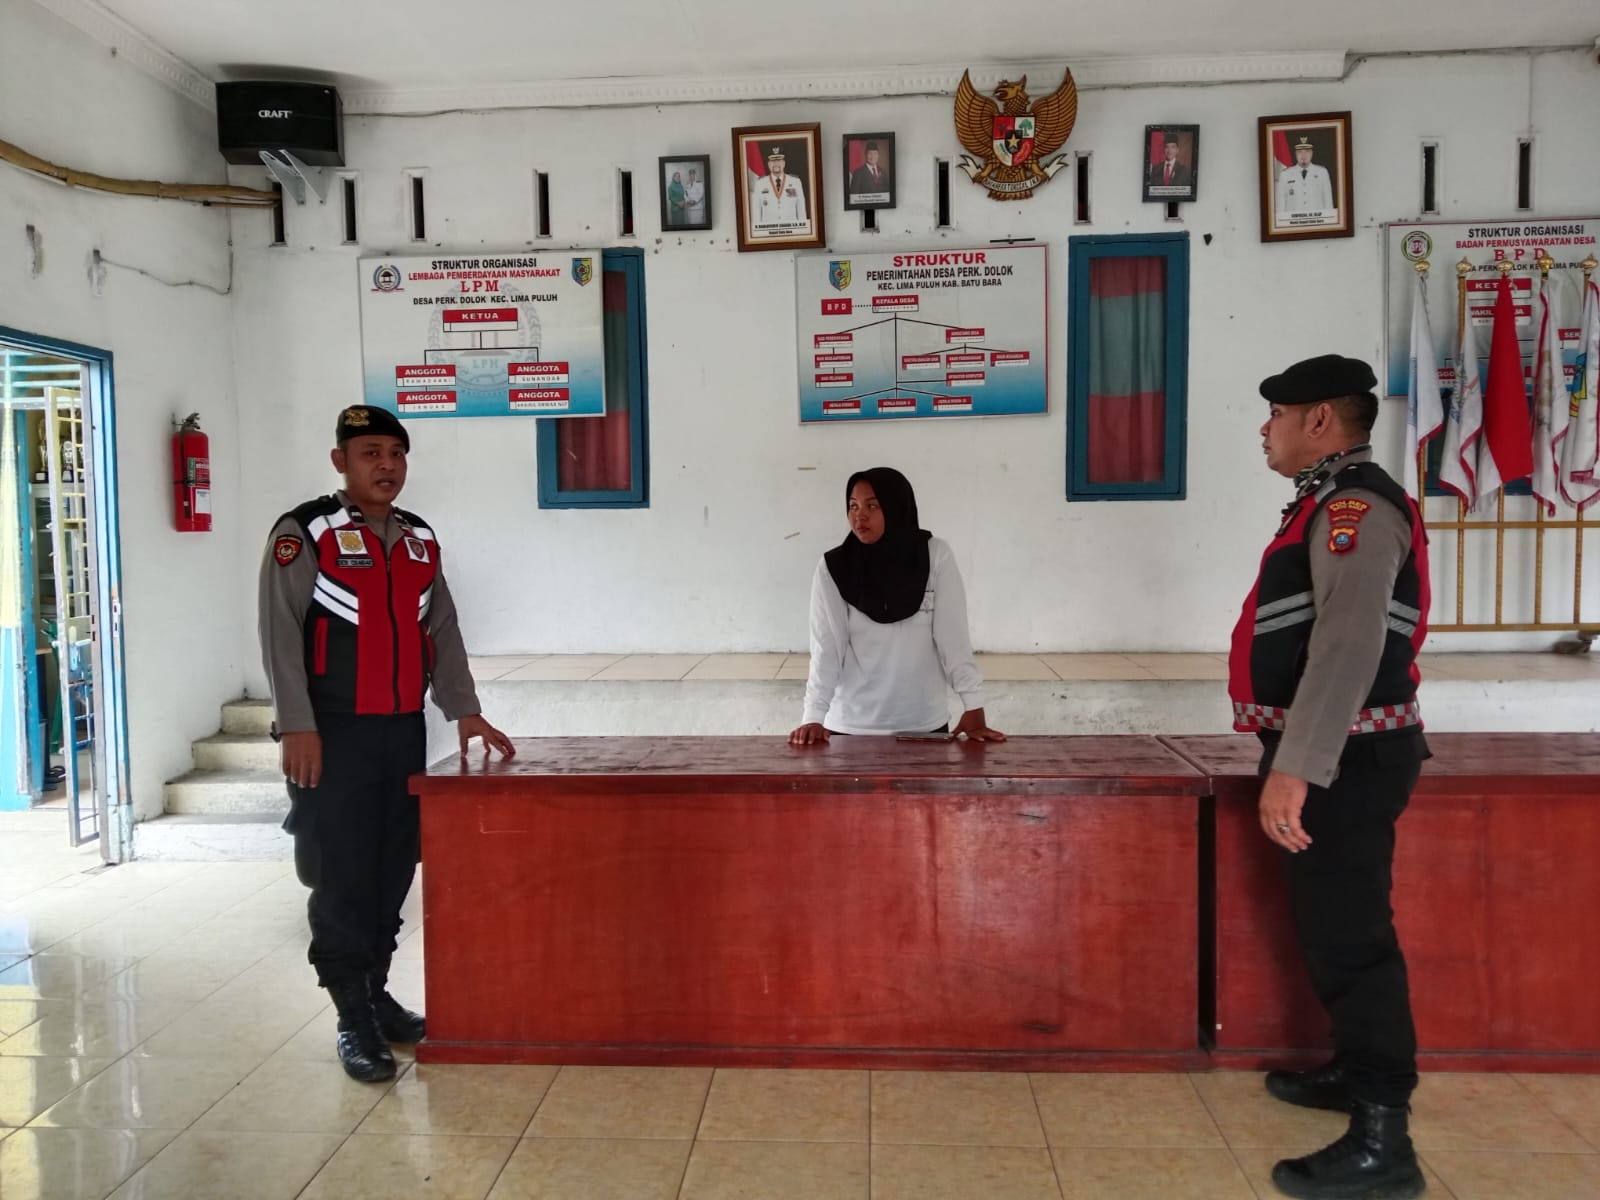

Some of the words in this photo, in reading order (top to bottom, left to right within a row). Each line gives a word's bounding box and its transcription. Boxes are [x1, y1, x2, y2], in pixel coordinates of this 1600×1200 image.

[258, 109, 289, 118] CRAFT
[1468, 227, 1521, 238] STRUKTUR
[1523, 225, 1584, 236] ORGANISASI
[1456, 240, 1484, 248] BADAN
[1486, 237, 1571, 247] PERMUSYAWARATAN
[1573, 236, 1596, 245] DESA
[432, 260, 480, 270] STRUKTUR
[482, 258, 537, 269] ORGANISASI
[893, 252, 986, 267] STRUKTUR
[408, 271, 445, 281] LEMBAGA
[446, 270, 507, 280] PEMBERDAYAAN
[509, 269, 561, 278] MASYARAKAT
[866, 270, 931, 281] PEMERINTAHAN
[933, 268, 955, 278] DESA
[957, 267, 982, 277] PERK.
[984, 265, 1013, 276] DOLOK
[460, 280, 499, 293] LPM
[878, 282, 895, 291] KEC.
[896, 281, 914, 290] LIMA
[916, 281, 940, 289] PULUH
[942, 280, 959, 288] KAB.
[961, 279, 980, 287] BATU
[982, 278, 1002, 286] BARA
[413, 297, 433, 305] DESA
[435, 297, 458, 305] PERK.
[460, 296, 486, 304] DOLOK
[490, 295, 509, 303] KEC.
[511, 295, 529, 303] LIMA
[531, 294, 558, 302] PULUH
[461, 312, 499, 320] KETUA
[518, 391, 560, 399] ANGGOTA
